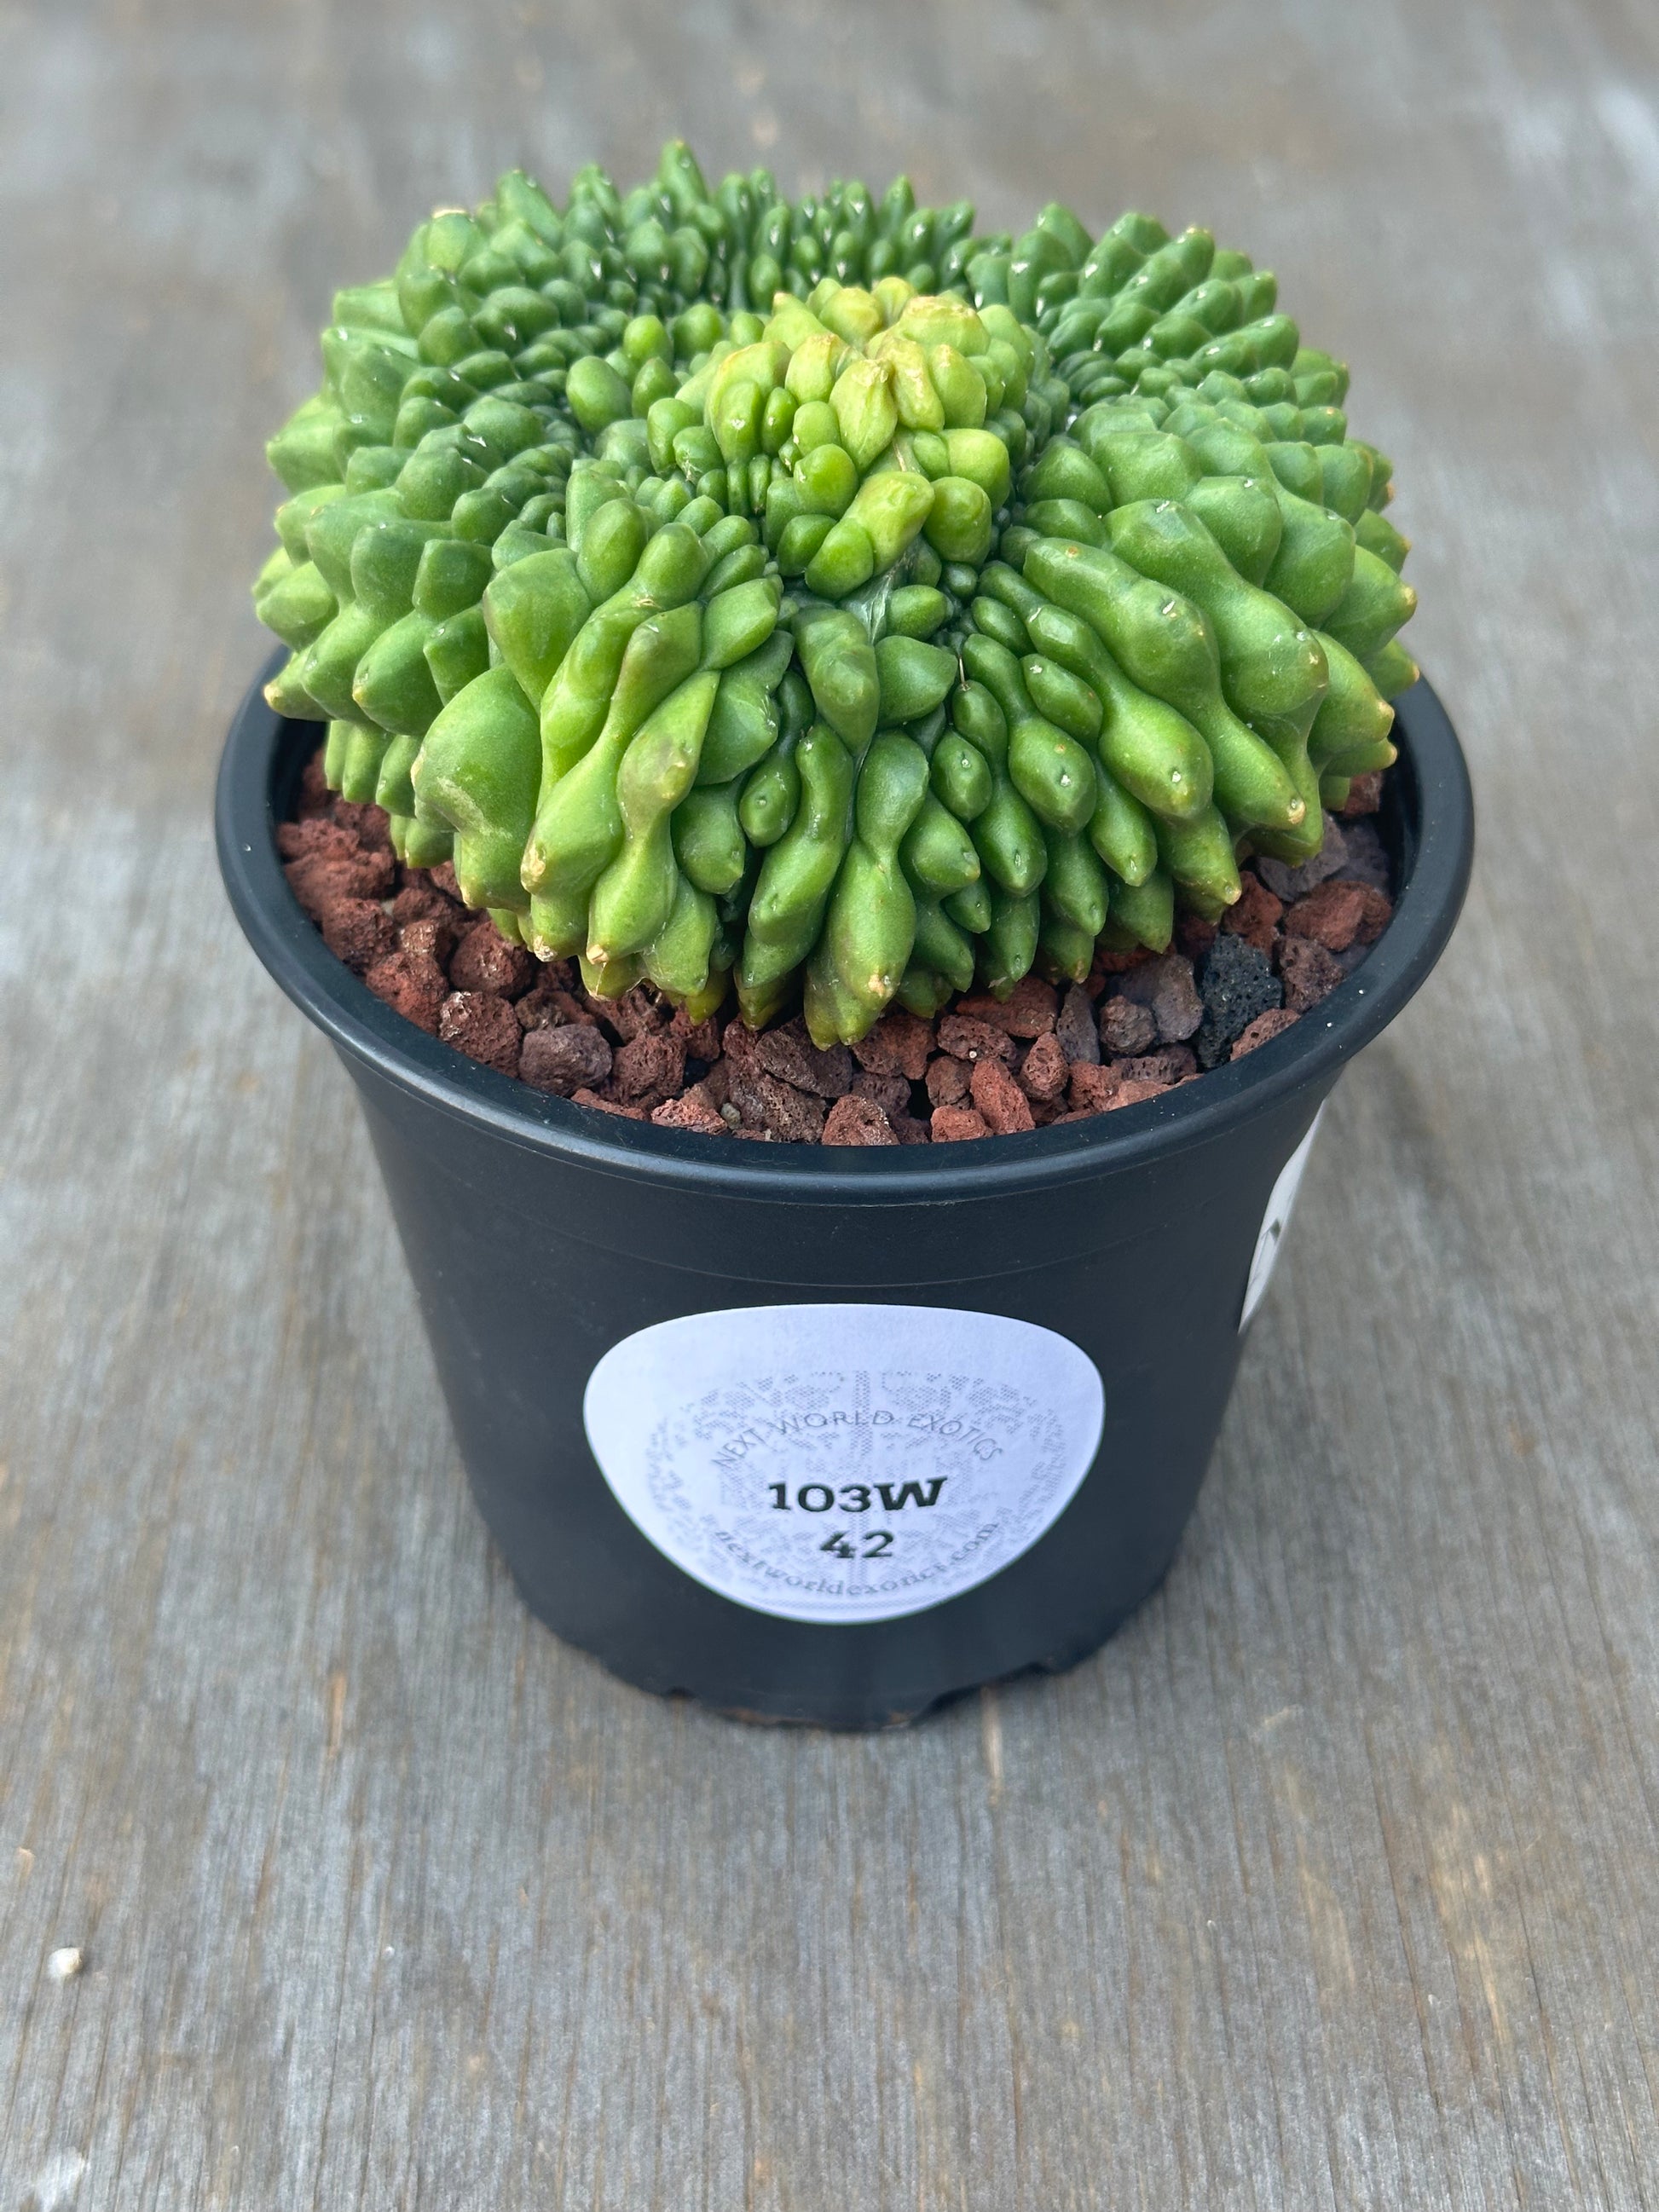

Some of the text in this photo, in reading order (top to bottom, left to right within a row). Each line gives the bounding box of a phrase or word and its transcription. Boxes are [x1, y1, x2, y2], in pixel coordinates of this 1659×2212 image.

[711, 1410, 1003, 1469] NEXT WORLD EXOTICS
[768, 1476, 948, 1513] 103W
[819, 1529, 894, 1559] 42
